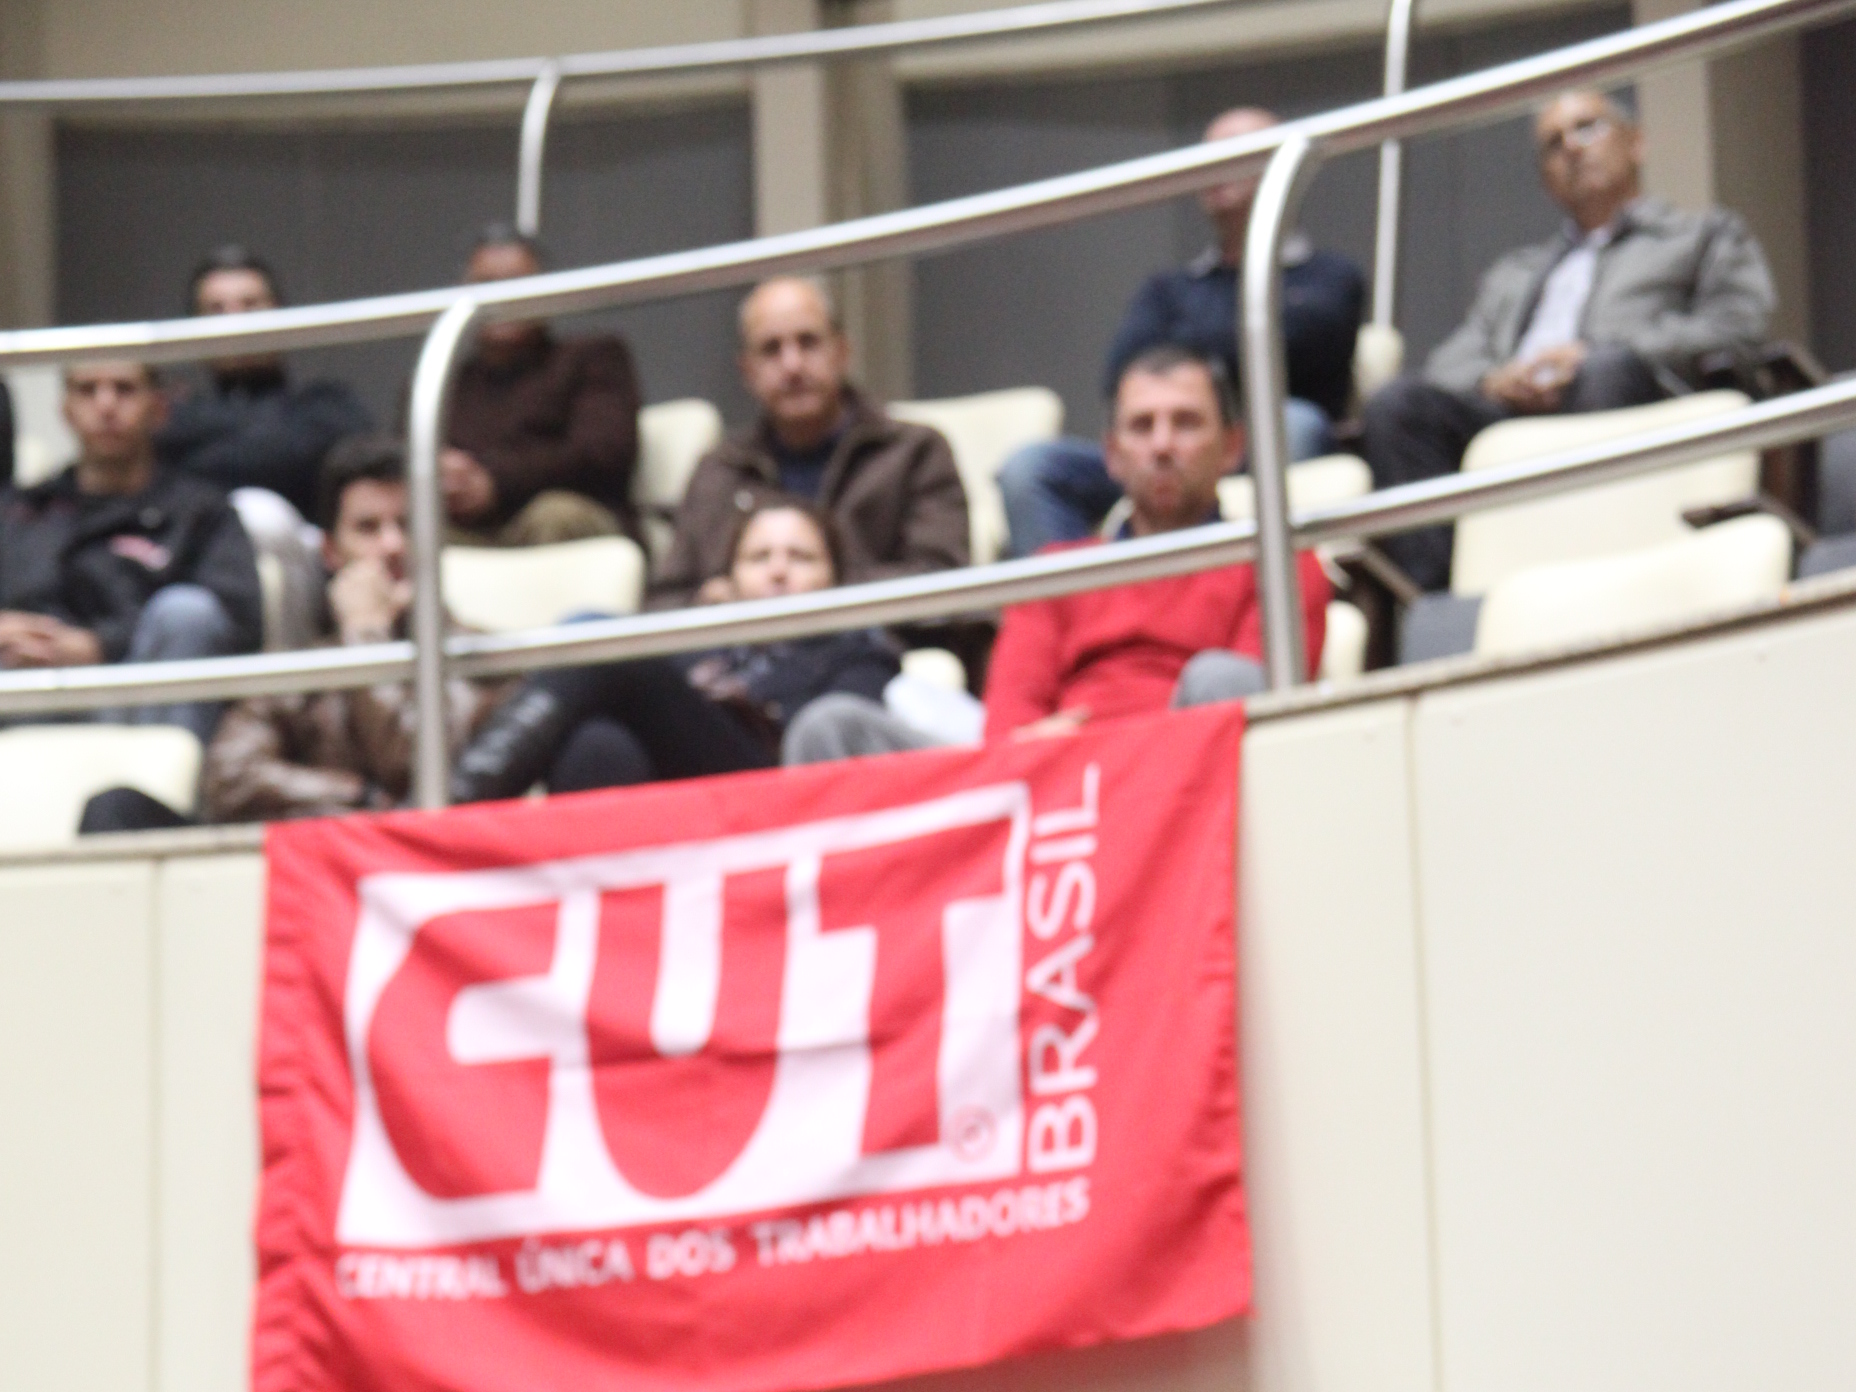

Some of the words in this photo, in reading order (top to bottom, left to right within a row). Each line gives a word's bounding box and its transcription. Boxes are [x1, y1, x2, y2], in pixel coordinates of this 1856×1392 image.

[364, 820, 1008, 1203] CUT
[1027, 763, 1100, 1173] BRASIL
[336, 1253, 508, 1300] CENTRAL
[514, 1236, 635, 1293] ÚNICA
[646, 1226, 736, 1280] DOS
[752, 1175, 1091, 1268] TRABALHADORES
